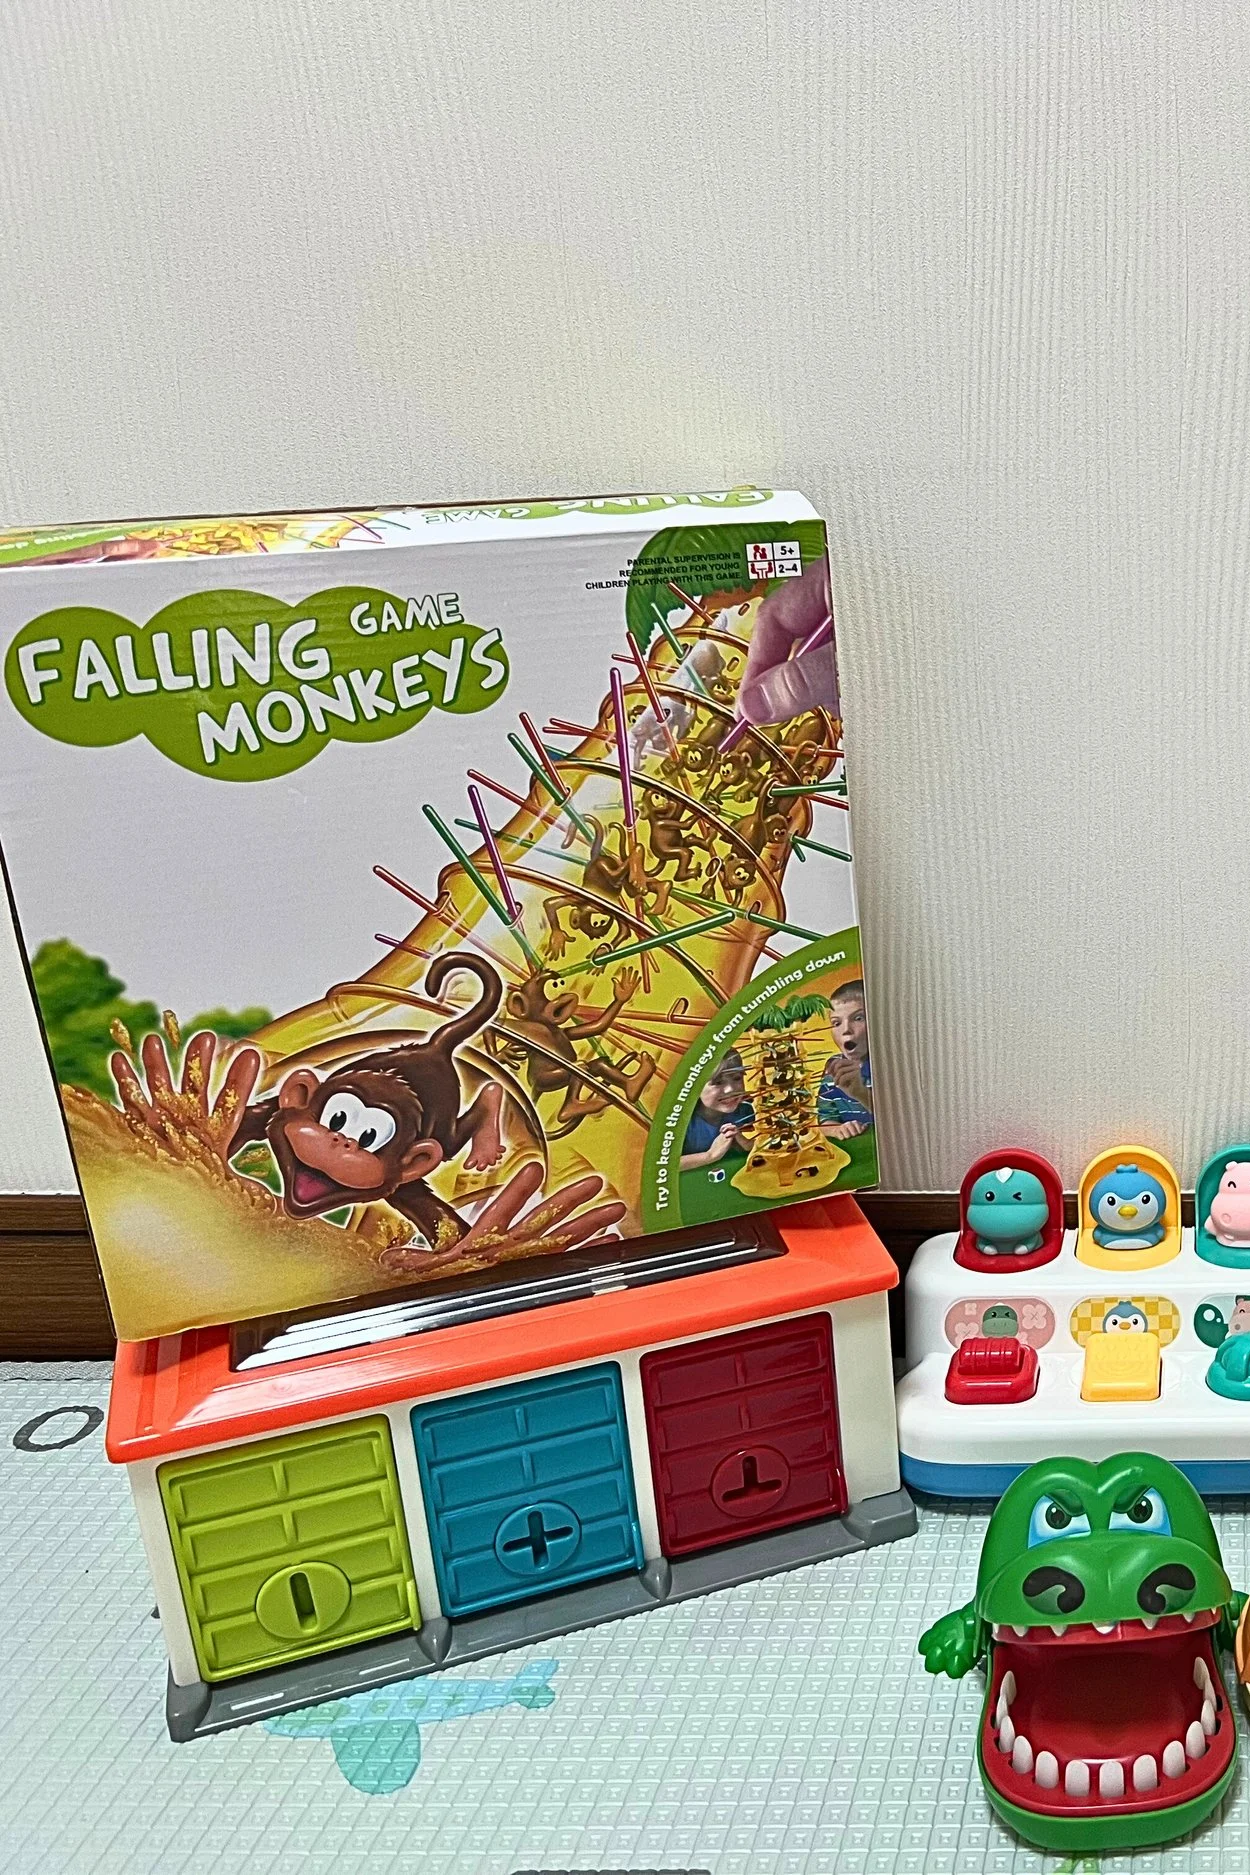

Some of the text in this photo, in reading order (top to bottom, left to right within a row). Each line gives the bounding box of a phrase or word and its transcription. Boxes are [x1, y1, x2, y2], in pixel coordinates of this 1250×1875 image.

[627, 552, 741, 567] PARENTAL SUPERVISION IS
[780, 545, 795, 556] 5+
[585, 579, 631, 590] CHILDREN
[632, 576, 670, 587] PLAYING
[671, 575, 694, 584] WITH
[694, 573, 715, 582] THIS
[619, 562, 740, 577] RECOMMENDED FOR YOUNG
[350, 592, 464, 636] GAME
[17, 618, 332, 705] FALLING
[197, 628, 507, 765] MONKEYS
[656, 950, 846, 1211] Try to keep the monkeys from tumbling down
